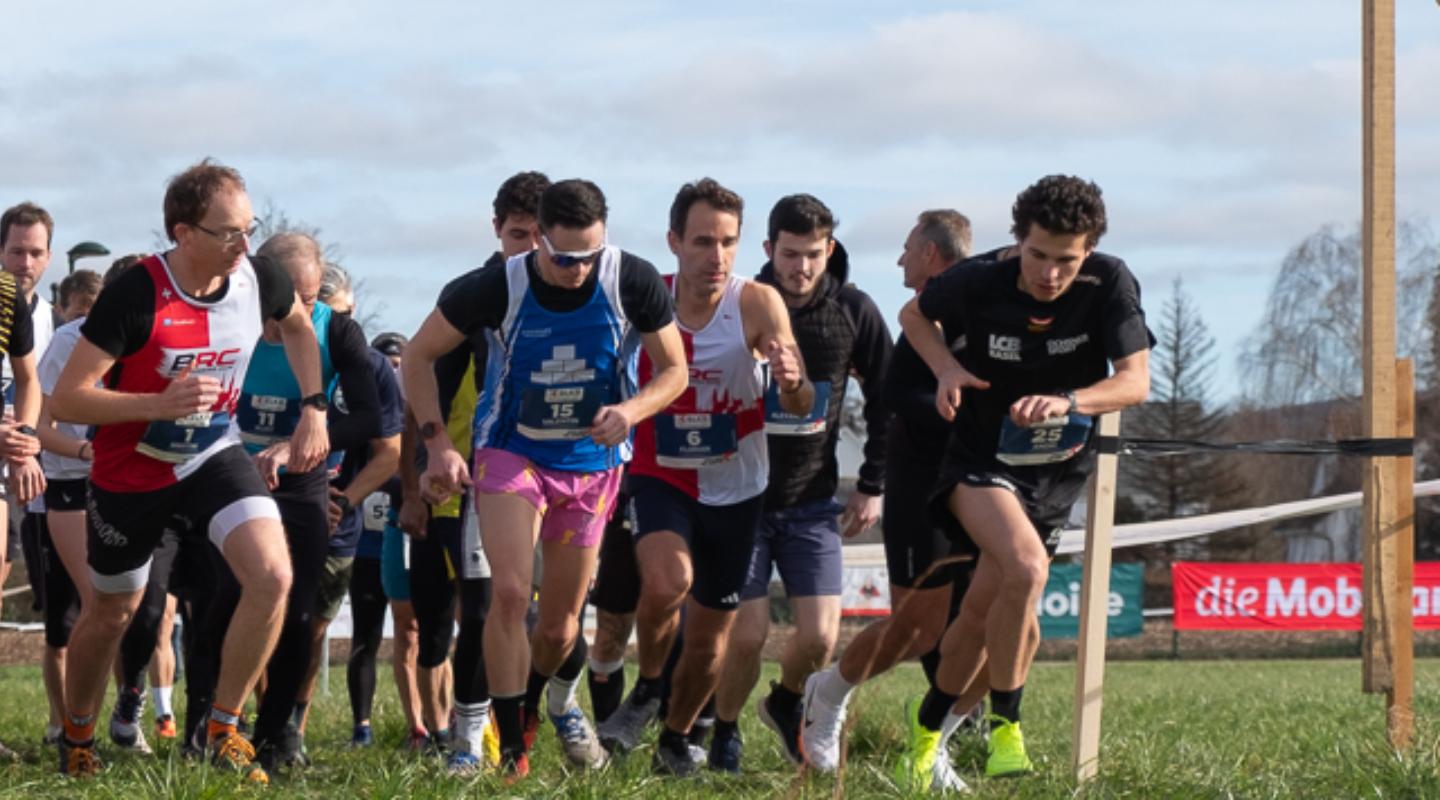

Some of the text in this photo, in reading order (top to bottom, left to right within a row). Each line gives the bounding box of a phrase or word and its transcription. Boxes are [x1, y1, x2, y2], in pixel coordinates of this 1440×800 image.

[171, 348, 241, 371] BRC
[688, 368, 722, 381] RC
[551, 403, 574, 418] 15
[258, 412, 275, 426] 11
[687, 431, 702, 446] 6
[1032, 429, 1062, 443] 25
[1195, 576, 1259, 617] die
